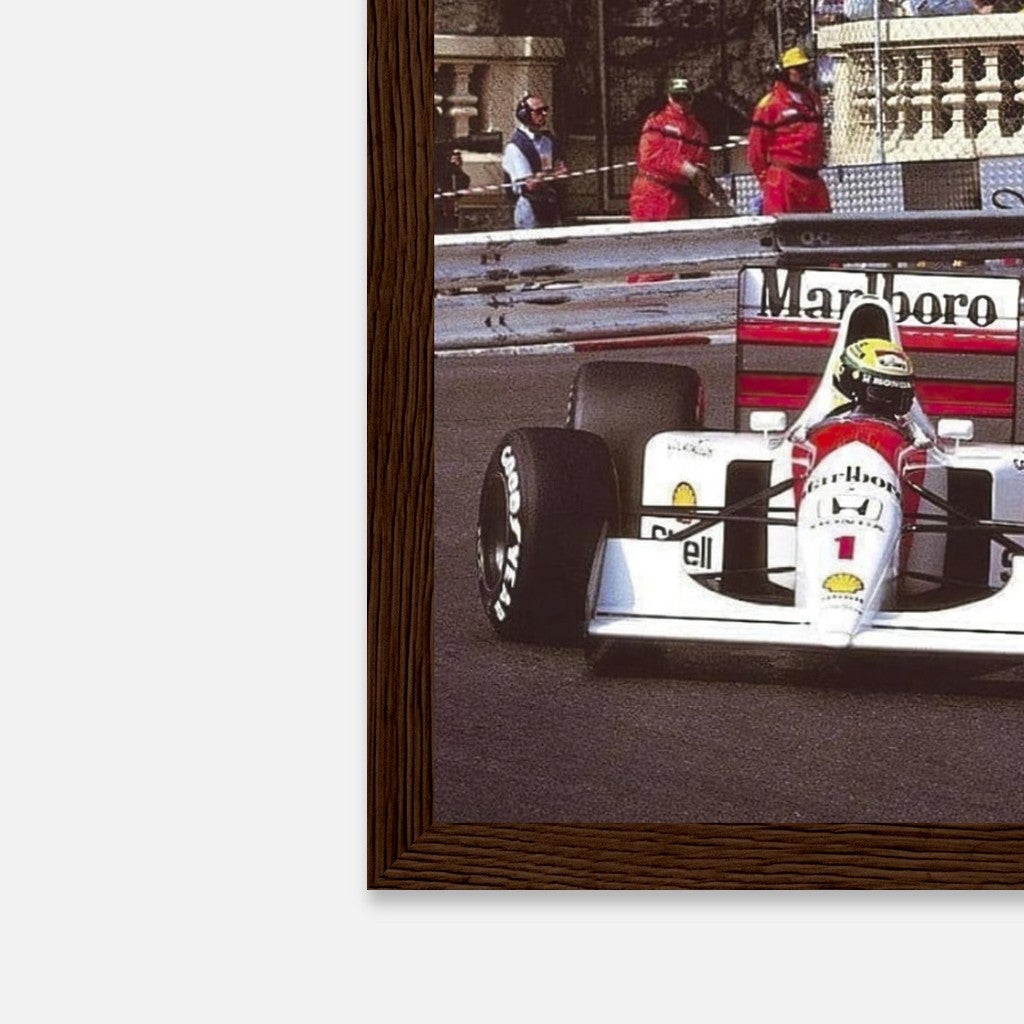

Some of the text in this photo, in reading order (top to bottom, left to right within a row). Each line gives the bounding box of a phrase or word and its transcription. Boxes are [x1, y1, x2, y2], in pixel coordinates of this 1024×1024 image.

[757, 268, 998, 327] Marlboro
[652, 524, 713, 570] Sell
[834, 536, 856, 560] 1
